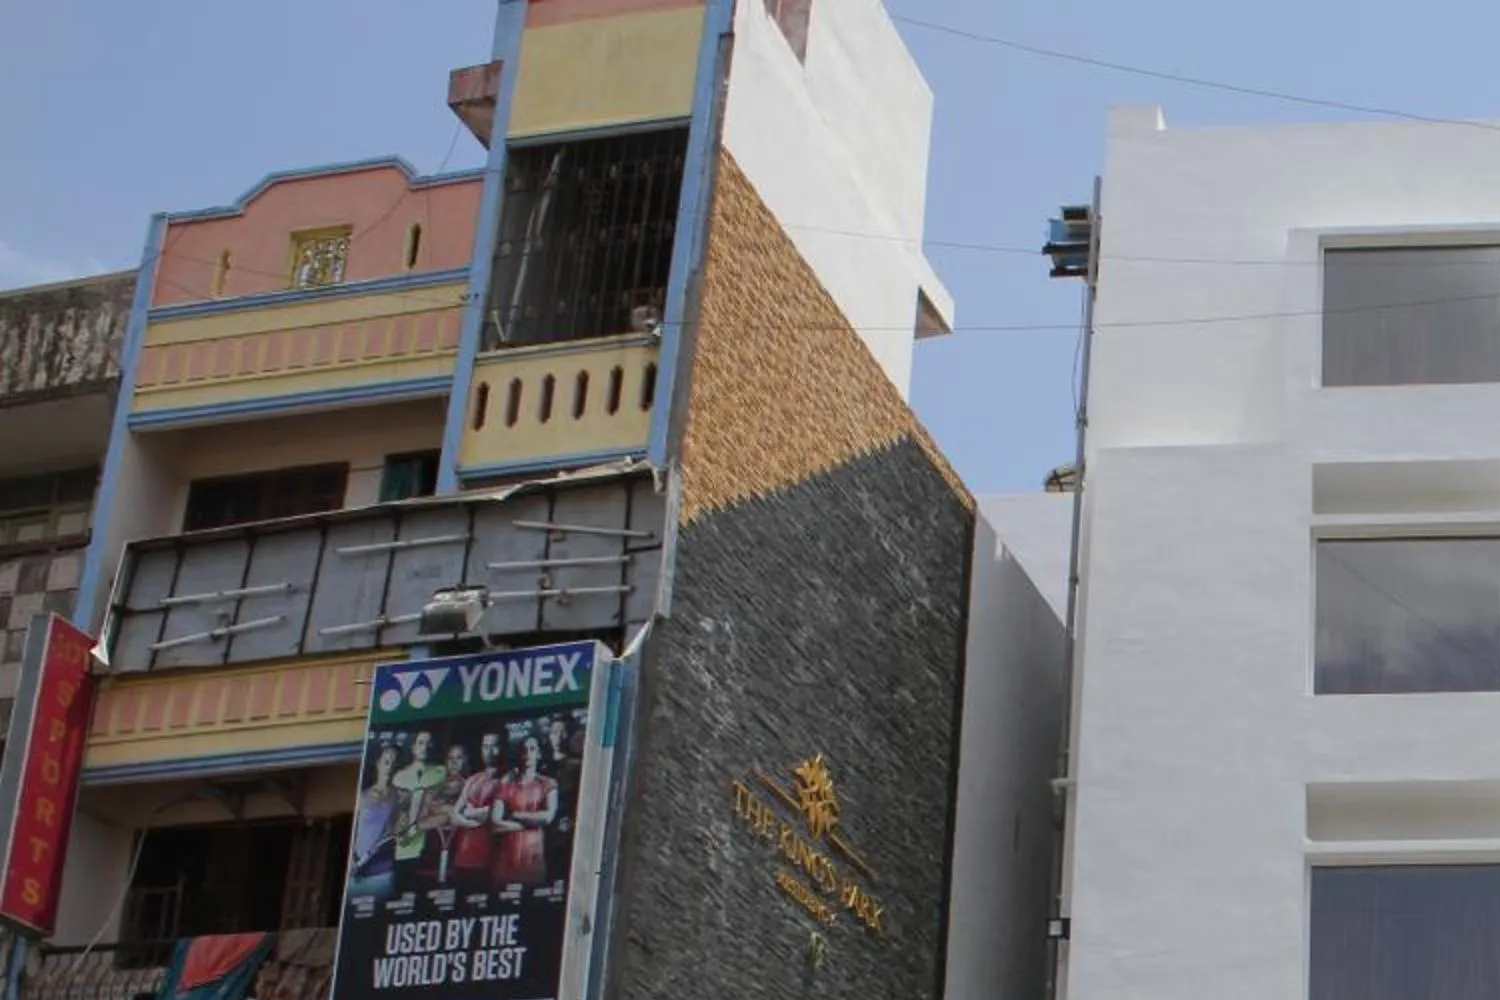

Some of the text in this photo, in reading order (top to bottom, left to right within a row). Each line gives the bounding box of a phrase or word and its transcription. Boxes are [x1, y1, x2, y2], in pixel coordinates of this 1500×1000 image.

[459, 652, 583, 702] YONEX
[386, 914, 521, 955] USED BY THE
[373, 947, 527, 989] WORLD'S BEST
